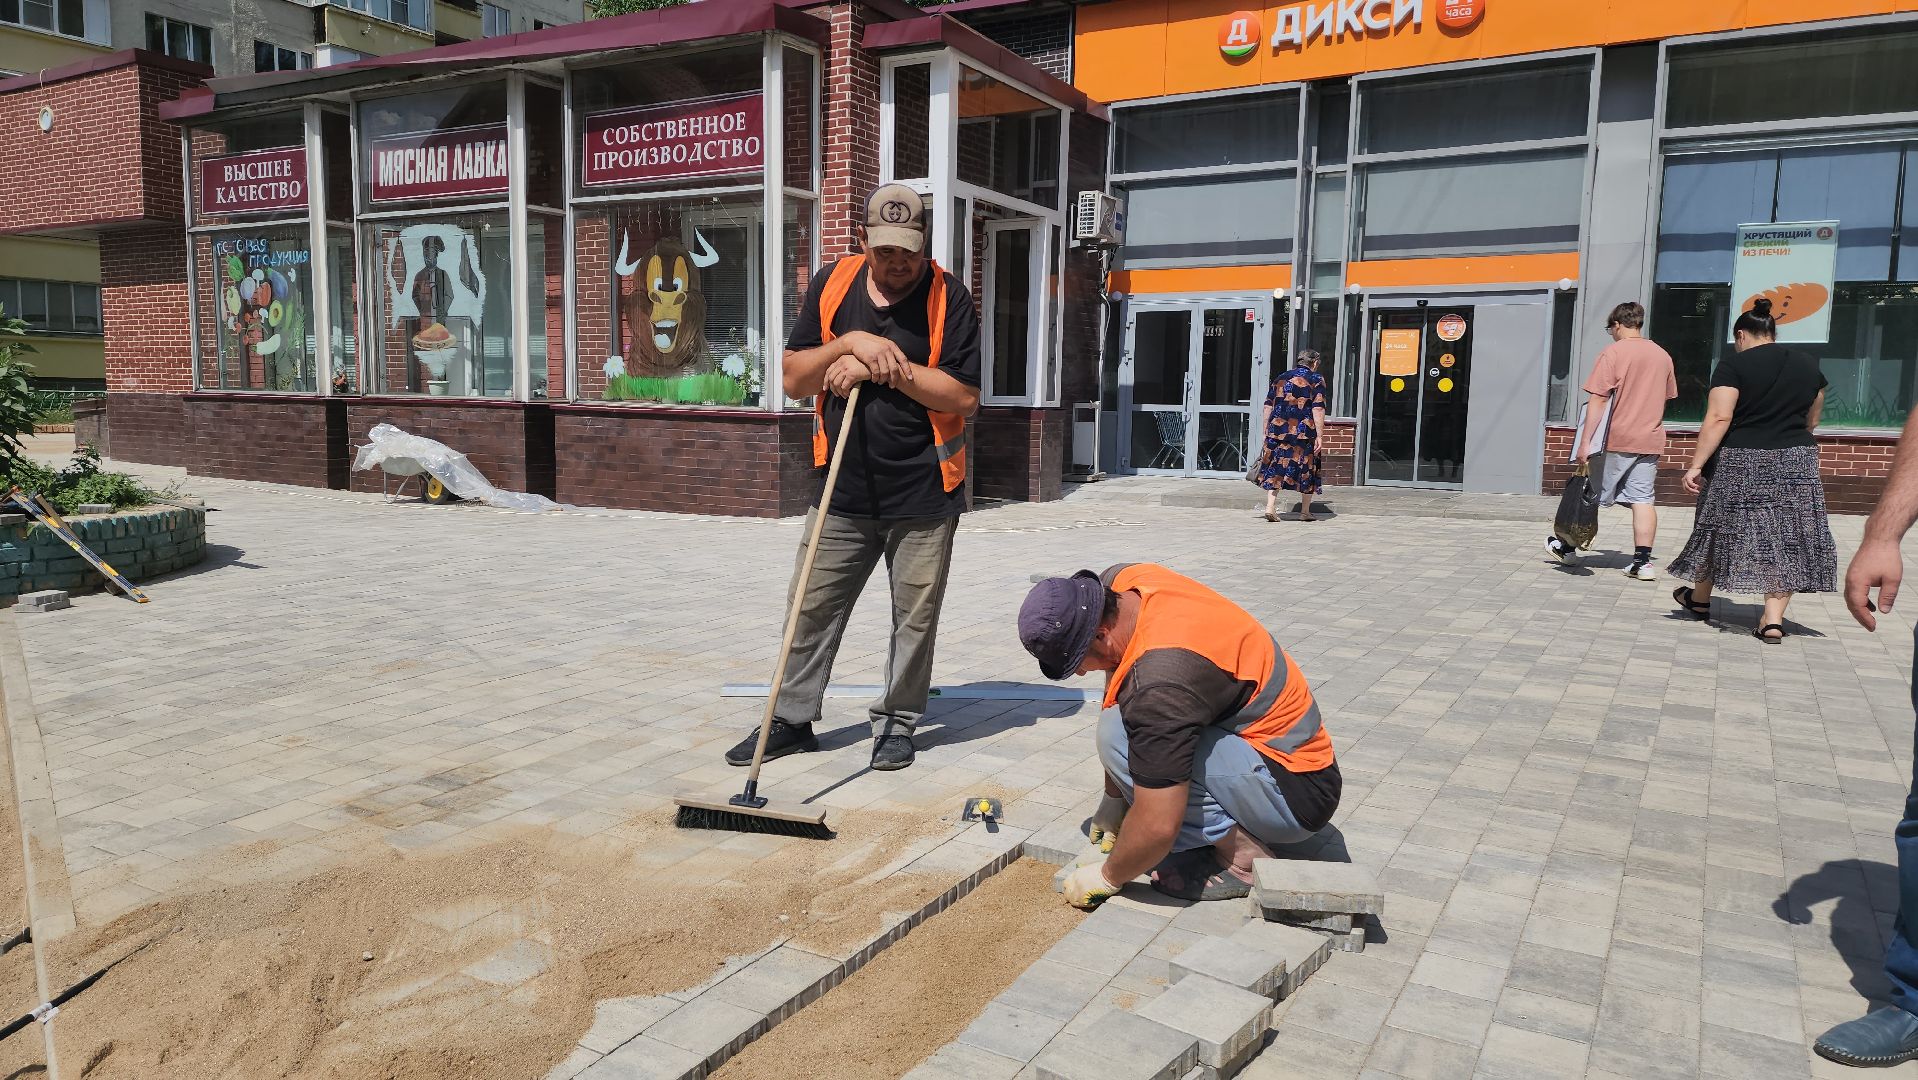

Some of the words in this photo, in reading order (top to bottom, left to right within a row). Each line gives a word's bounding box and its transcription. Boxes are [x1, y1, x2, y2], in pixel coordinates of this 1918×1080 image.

[1271, 0, 1422, 47] ДИКСИ
[1446, 7, 1472, 17] часа
[602, 111, 746, 146] СОБСТВЕННОЕ
[379, 145, 448, 187] МЯСНАЯ
[452, 139, 507, 181] ЛАВКА
[593, 136, 761, 171] ПРОИЗВОДСТВО
[224, 159, 292, 182] ВЫСШЕЕ
[215, 181, 301, 204] КАЧЕСТВО
[1744, 228, 1812, 240] ХРУСТЯЩИЙ
[1744, 239, 1789, 248] СВЕЖИЙ
